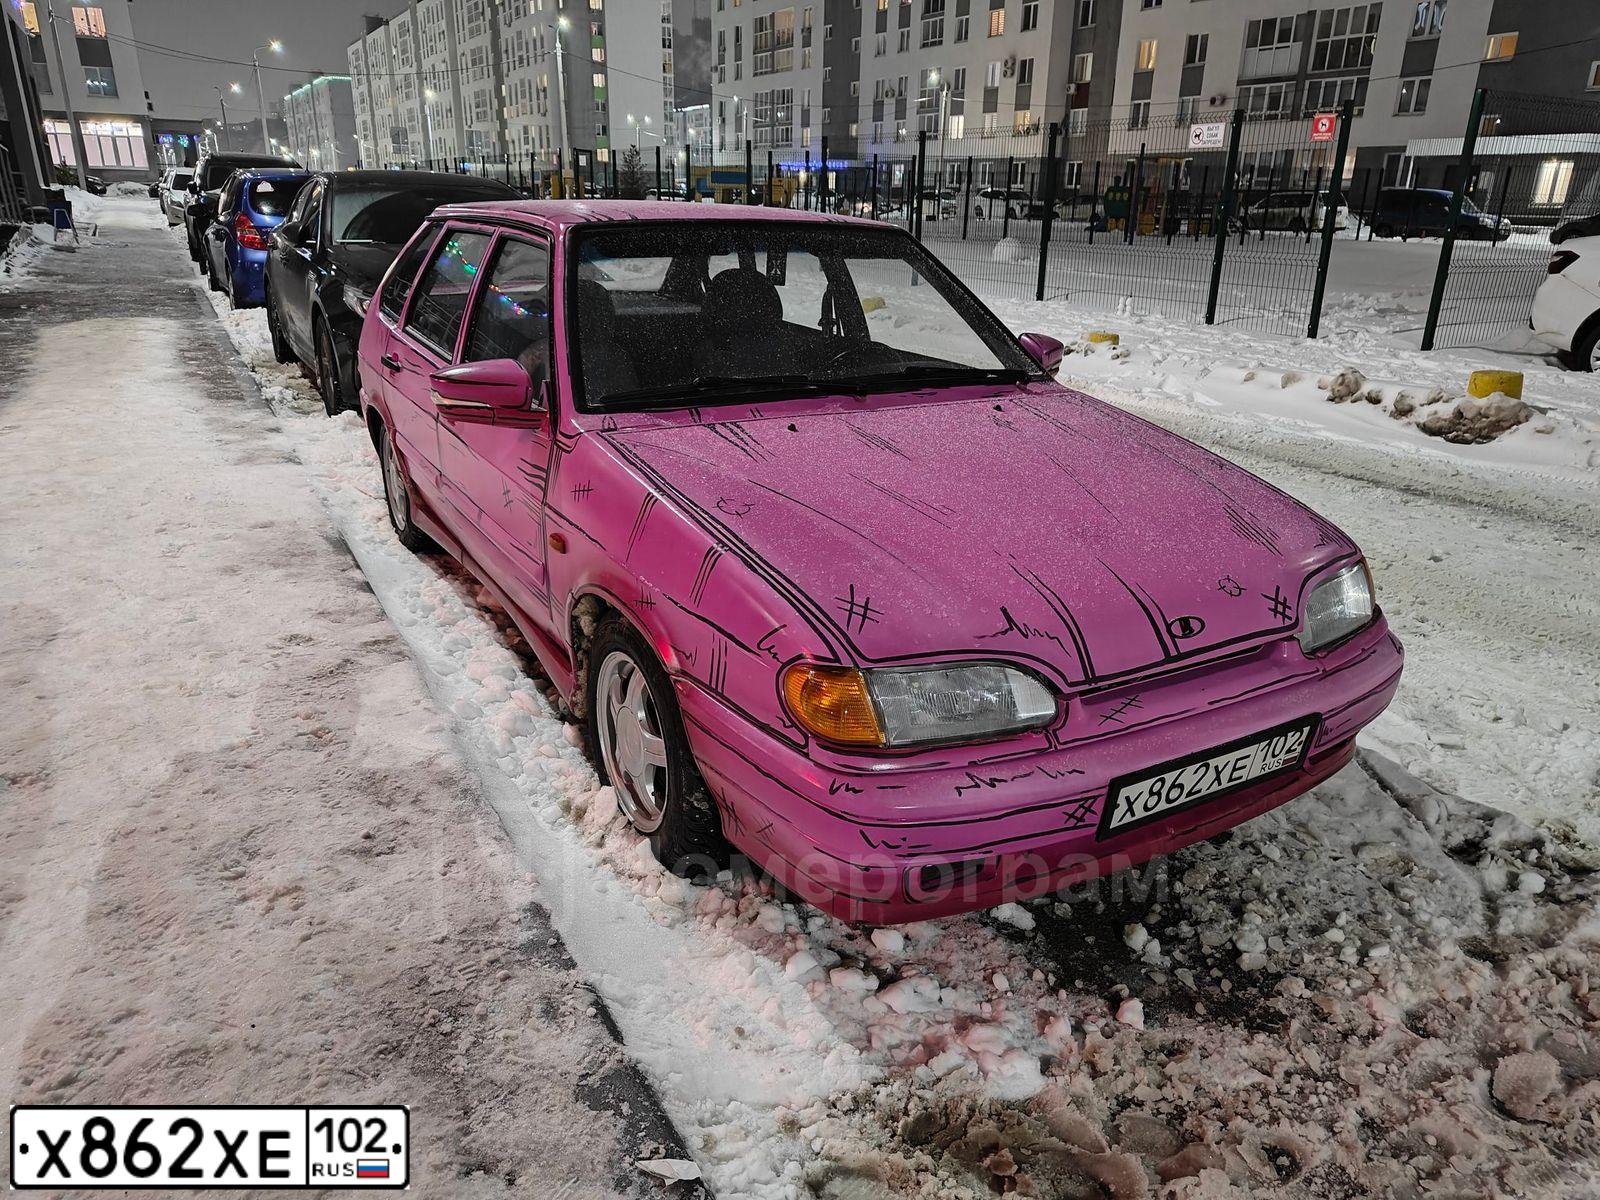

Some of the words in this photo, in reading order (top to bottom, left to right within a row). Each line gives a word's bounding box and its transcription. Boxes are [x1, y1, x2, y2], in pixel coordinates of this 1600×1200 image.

[1118, 753, 1252, 824] Х862ХЕ
[1260, 729, 1303, 762] 102
[1260, 759, 1282, 773] RUS
